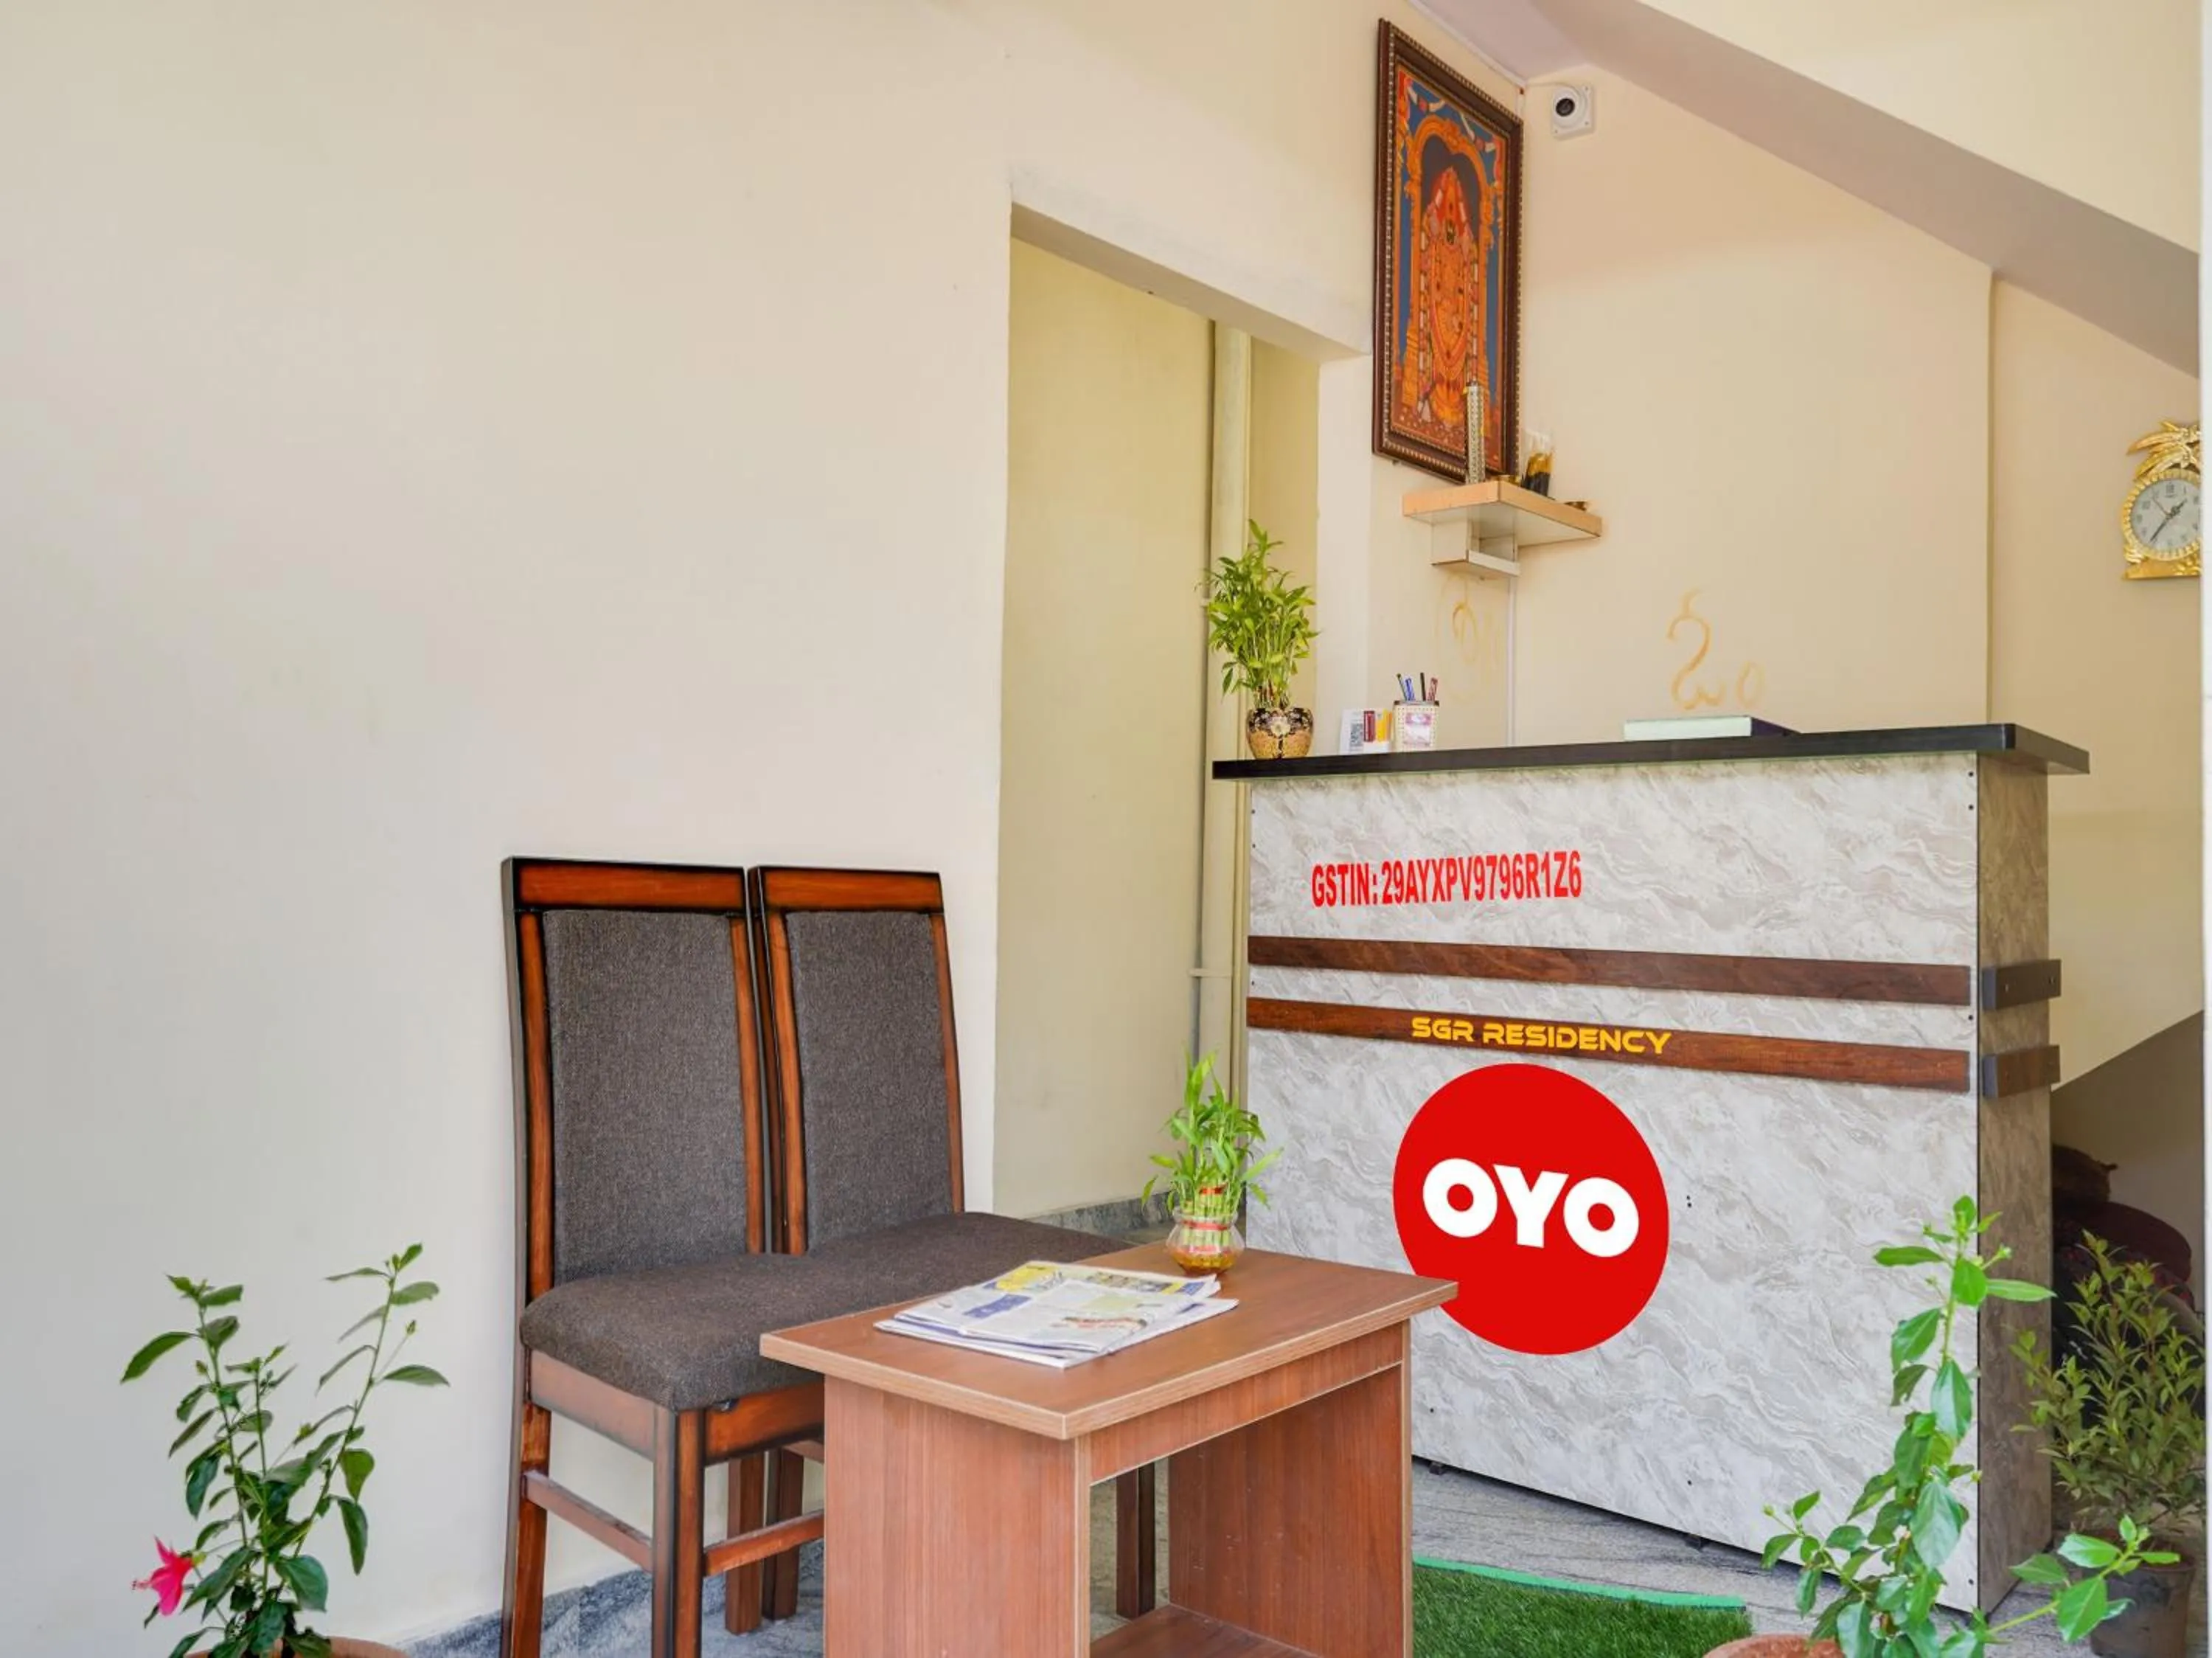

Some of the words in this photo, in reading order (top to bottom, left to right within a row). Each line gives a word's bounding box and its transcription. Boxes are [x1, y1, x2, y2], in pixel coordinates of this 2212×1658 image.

[1311, 861, 1379, 908] GSTIN:
[1380, 850, 1583, 906] 29AYXPV9796R1Z6
[1411, 1016, 1474, 1043] SGR
[1483, 1022, 1672, 1055] RESIDENCY
[1422, 1158, 1640, 1258] OYO
